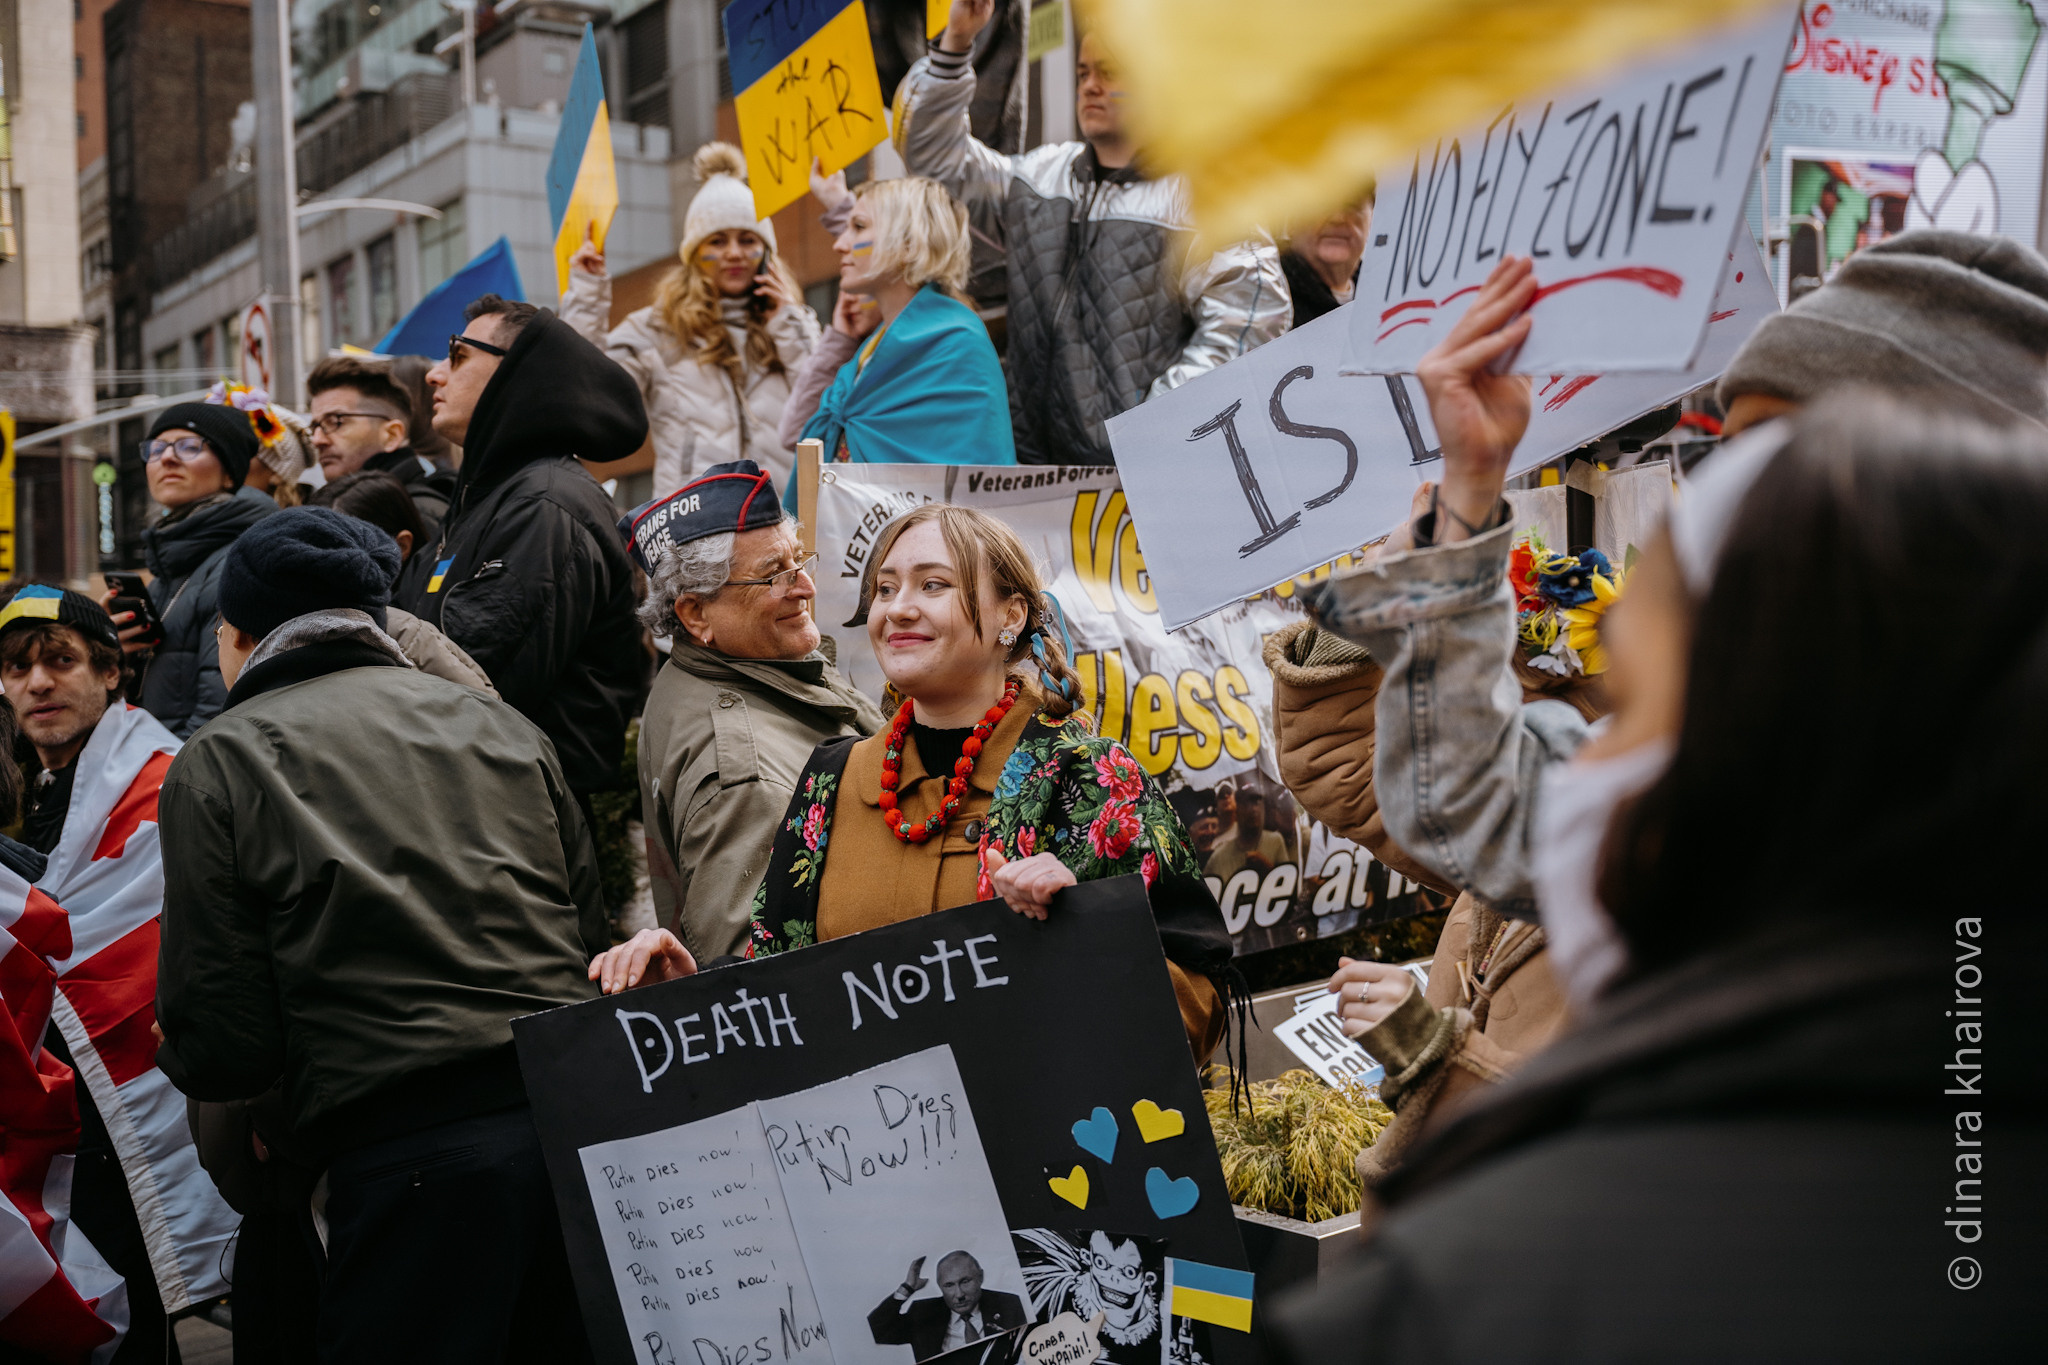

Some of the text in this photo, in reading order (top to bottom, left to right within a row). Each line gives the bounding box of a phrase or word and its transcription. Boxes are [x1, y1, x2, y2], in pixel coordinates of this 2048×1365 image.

[747, 0, 817, 61] STO
[760, 58, 874, 185] WAR
[1454, 101, 1554, 282] FLY
[1531, 55, 1756, 260] ZONE!
[1186, 365, 1360, 560] IS
[670, 494, 701, 520] FOR
[840, 491, 918, 578] VETERANS
[1312, 844, 1375, 917] at
[616, 933, 1010, 1093] DEATH NOTE
[766, 1084, 954, 1174] Putin Dies
[600, 1164, 636, 1190] Putin
[615, 1200, 645, 1224] Putin
[658, 1195, 695, 1216] Dies
[626, 1246, 763, 1286] Putin Dies now
[627, 1228, 659, 1251] Putin
[671, 1224, 706, 1246] Dies
[641, 1295, 671, 1312] Putin
[779, 1282, 828, 1363] Now
